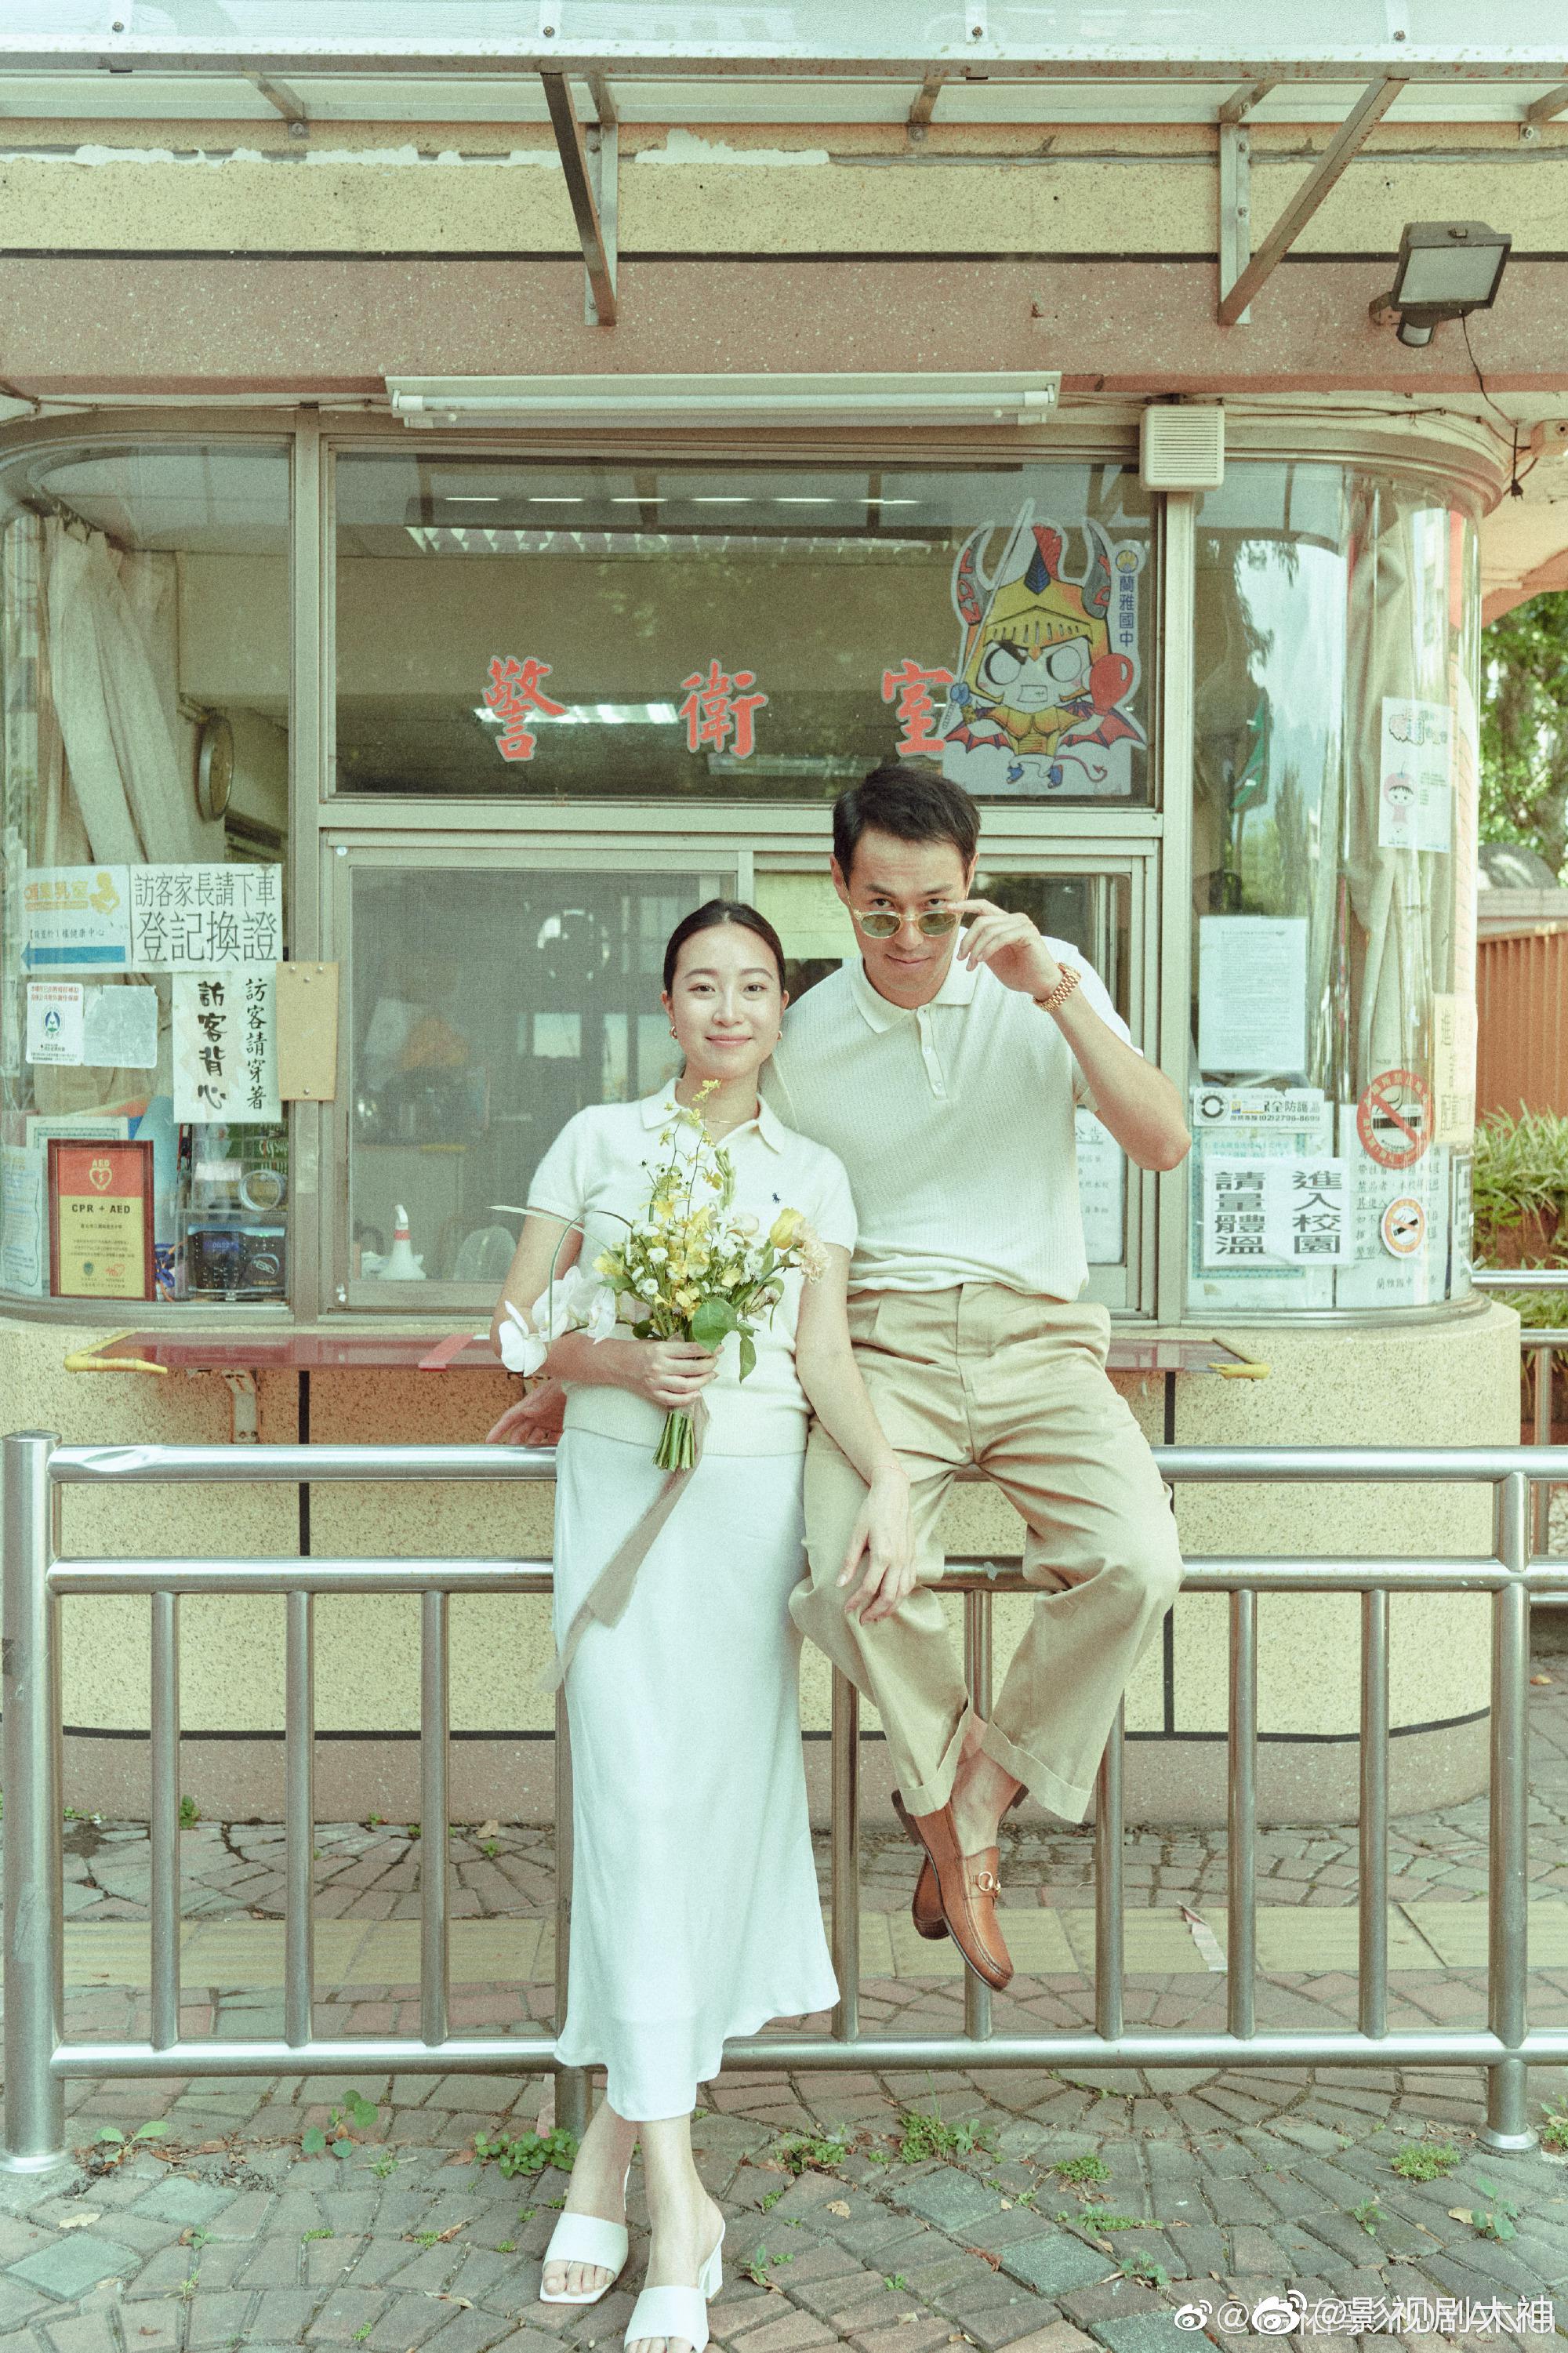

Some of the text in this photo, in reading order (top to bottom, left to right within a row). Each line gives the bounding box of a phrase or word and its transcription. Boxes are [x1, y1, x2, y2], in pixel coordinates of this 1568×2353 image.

[1120, 576, 1134, 647] 蘭雅國中
[484, 657, 954, 759] 警衛室
[135, 871, 275, 907] 訪客家長請下車
[136, 910, 278, 963] 登記換證
[198, 981, 227, 1109] 訪客背心
[245, 979, 267, 1110] 訪客請穿著
[92, 1159, 111, 1167] AED
[71, 1204, 94, 1213] CPR
[110, 1204, 131, 1214] AED
[1214, 1171, 1266, 1255] 請量體溫
[1292, 1171, 1342, 1255] 進入校園
